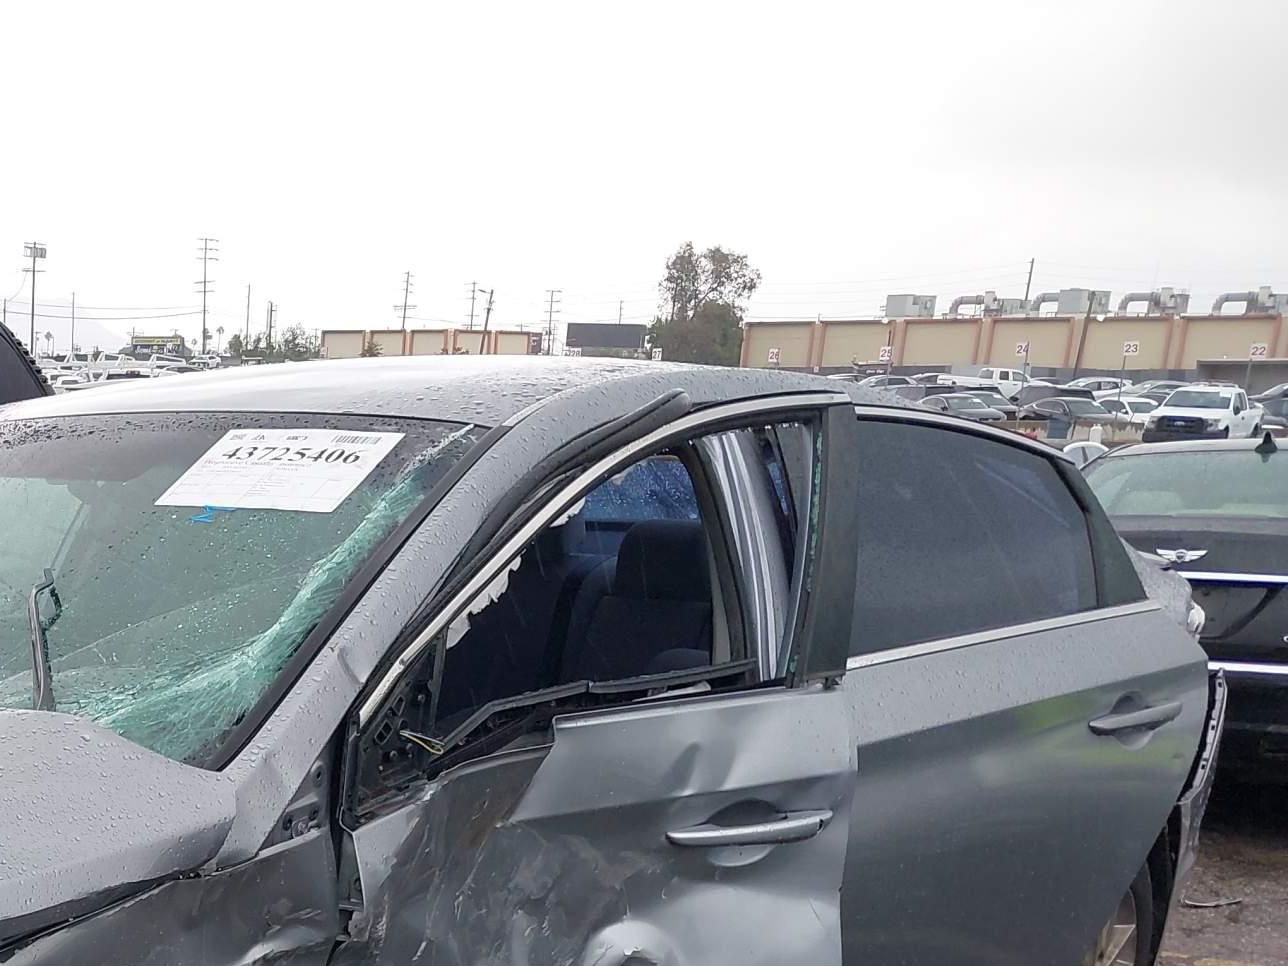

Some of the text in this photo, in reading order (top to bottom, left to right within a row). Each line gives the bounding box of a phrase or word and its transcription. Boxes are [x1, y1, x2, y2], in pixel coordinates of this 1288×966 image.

[880, 348, 892, 358] 25
[1016, 344, 1029, 354] 24
[1124, 344, 1138, 353] 23
[1251, 346, 1266, 356] 22
[652, 350, 662, 359] 27
[222, 446, 365, 464] 43725406
